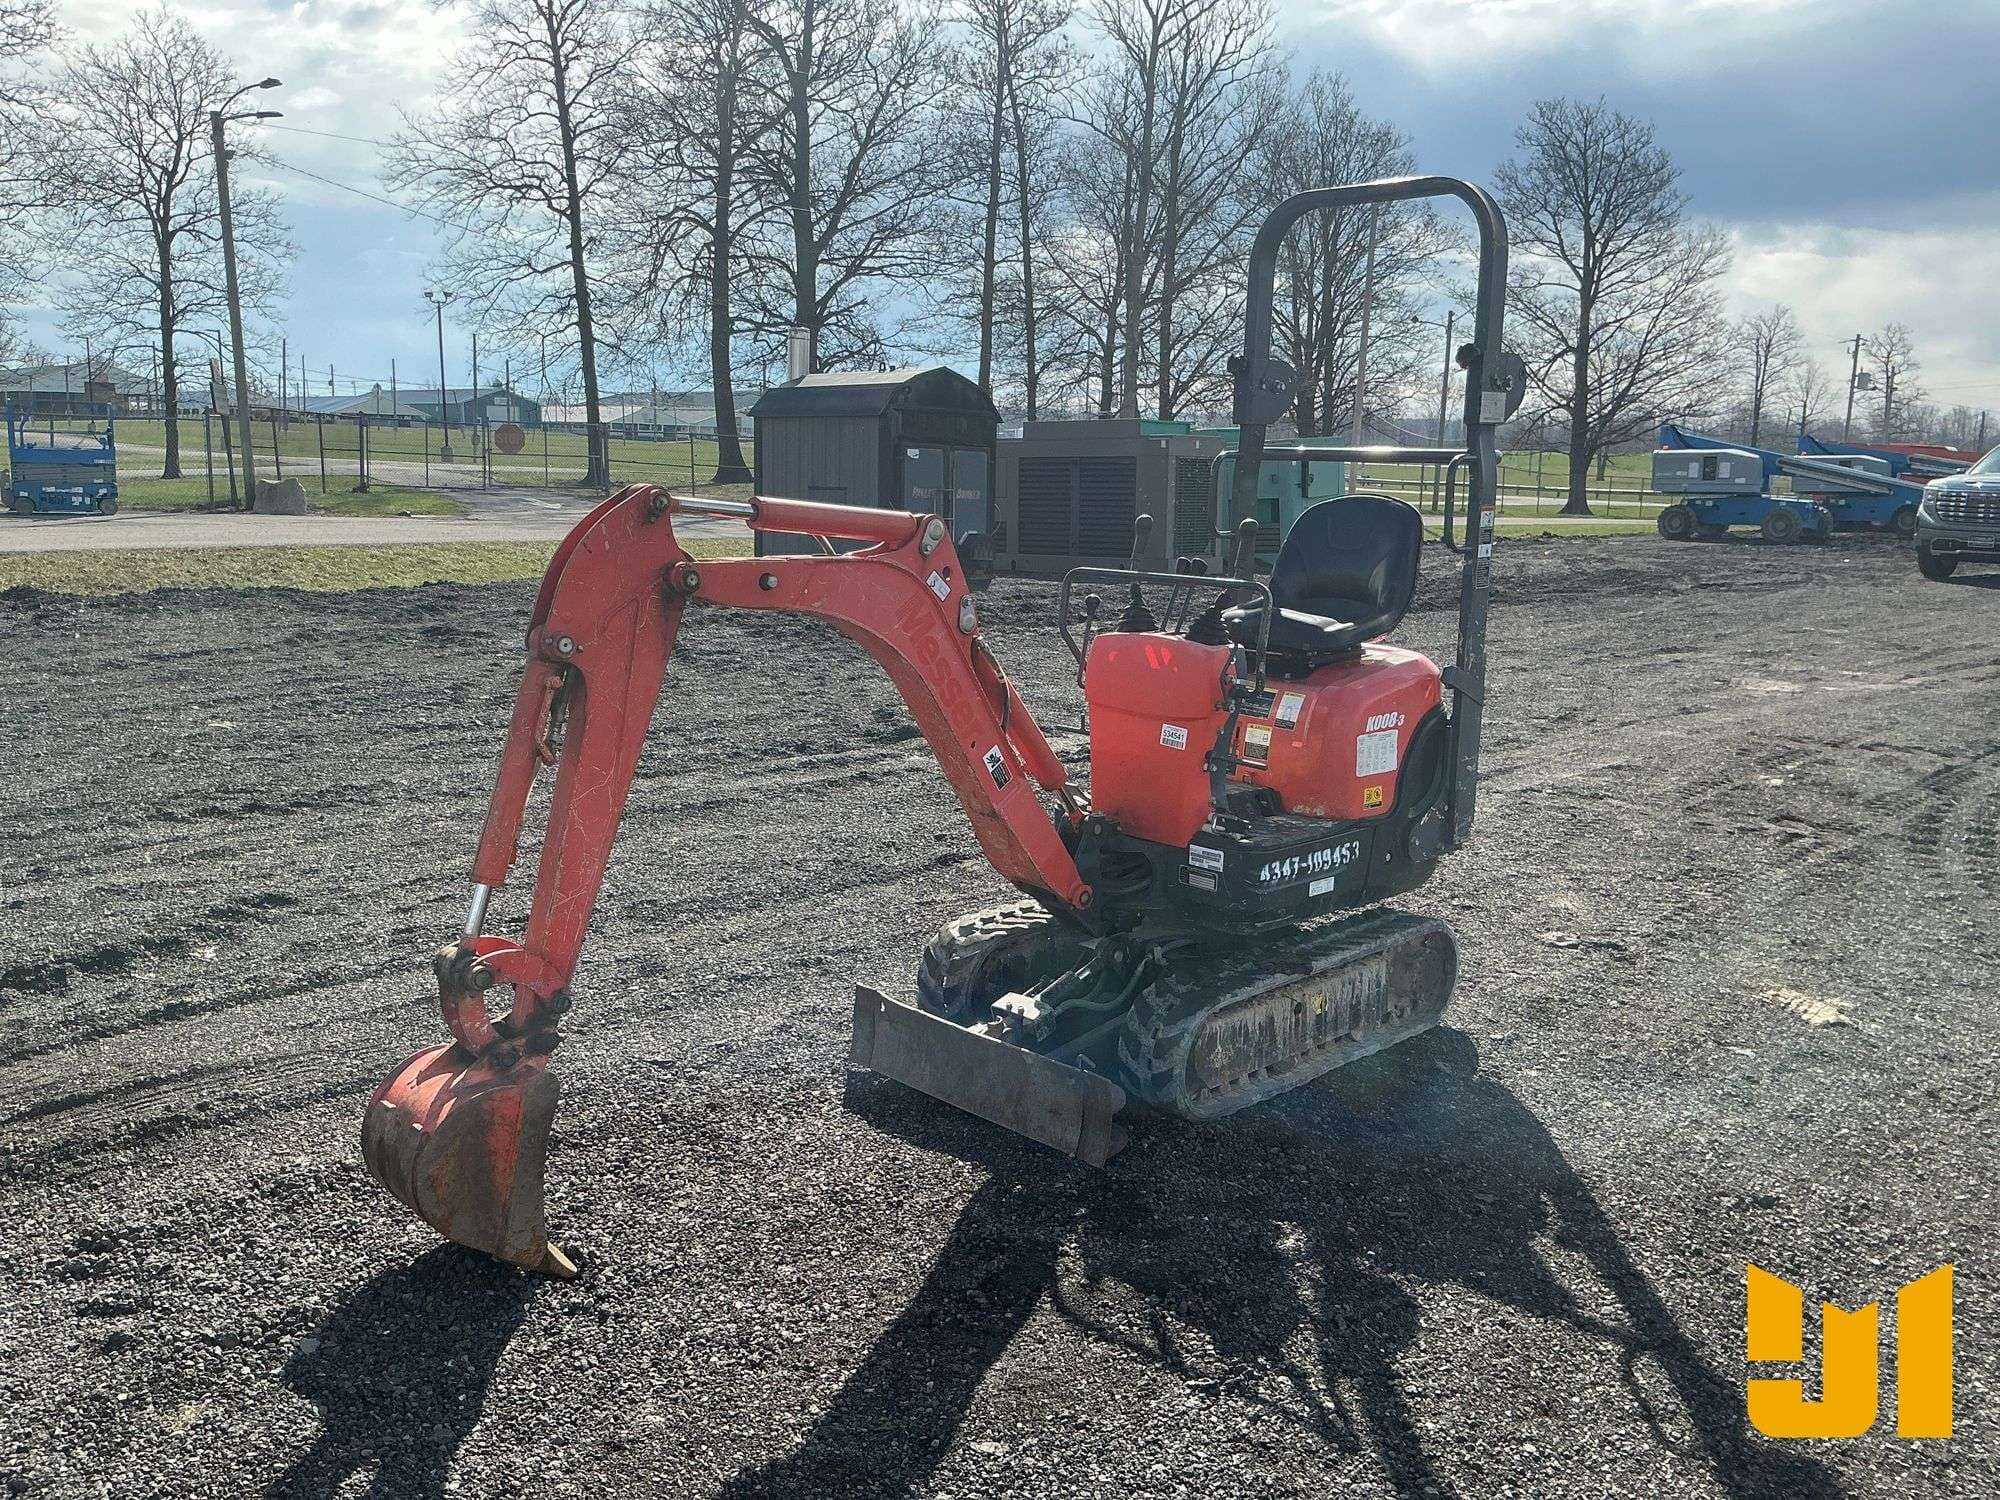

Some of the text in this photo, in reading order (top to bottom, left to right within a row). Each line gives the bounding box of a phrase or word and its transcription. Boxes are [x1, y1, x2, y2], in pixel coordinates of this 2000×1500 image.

[496, 433, 522, 445] STOP
[1162, 729, 1185, 742] 534541
[1259, 839, 1361, 882] 4347-109453
